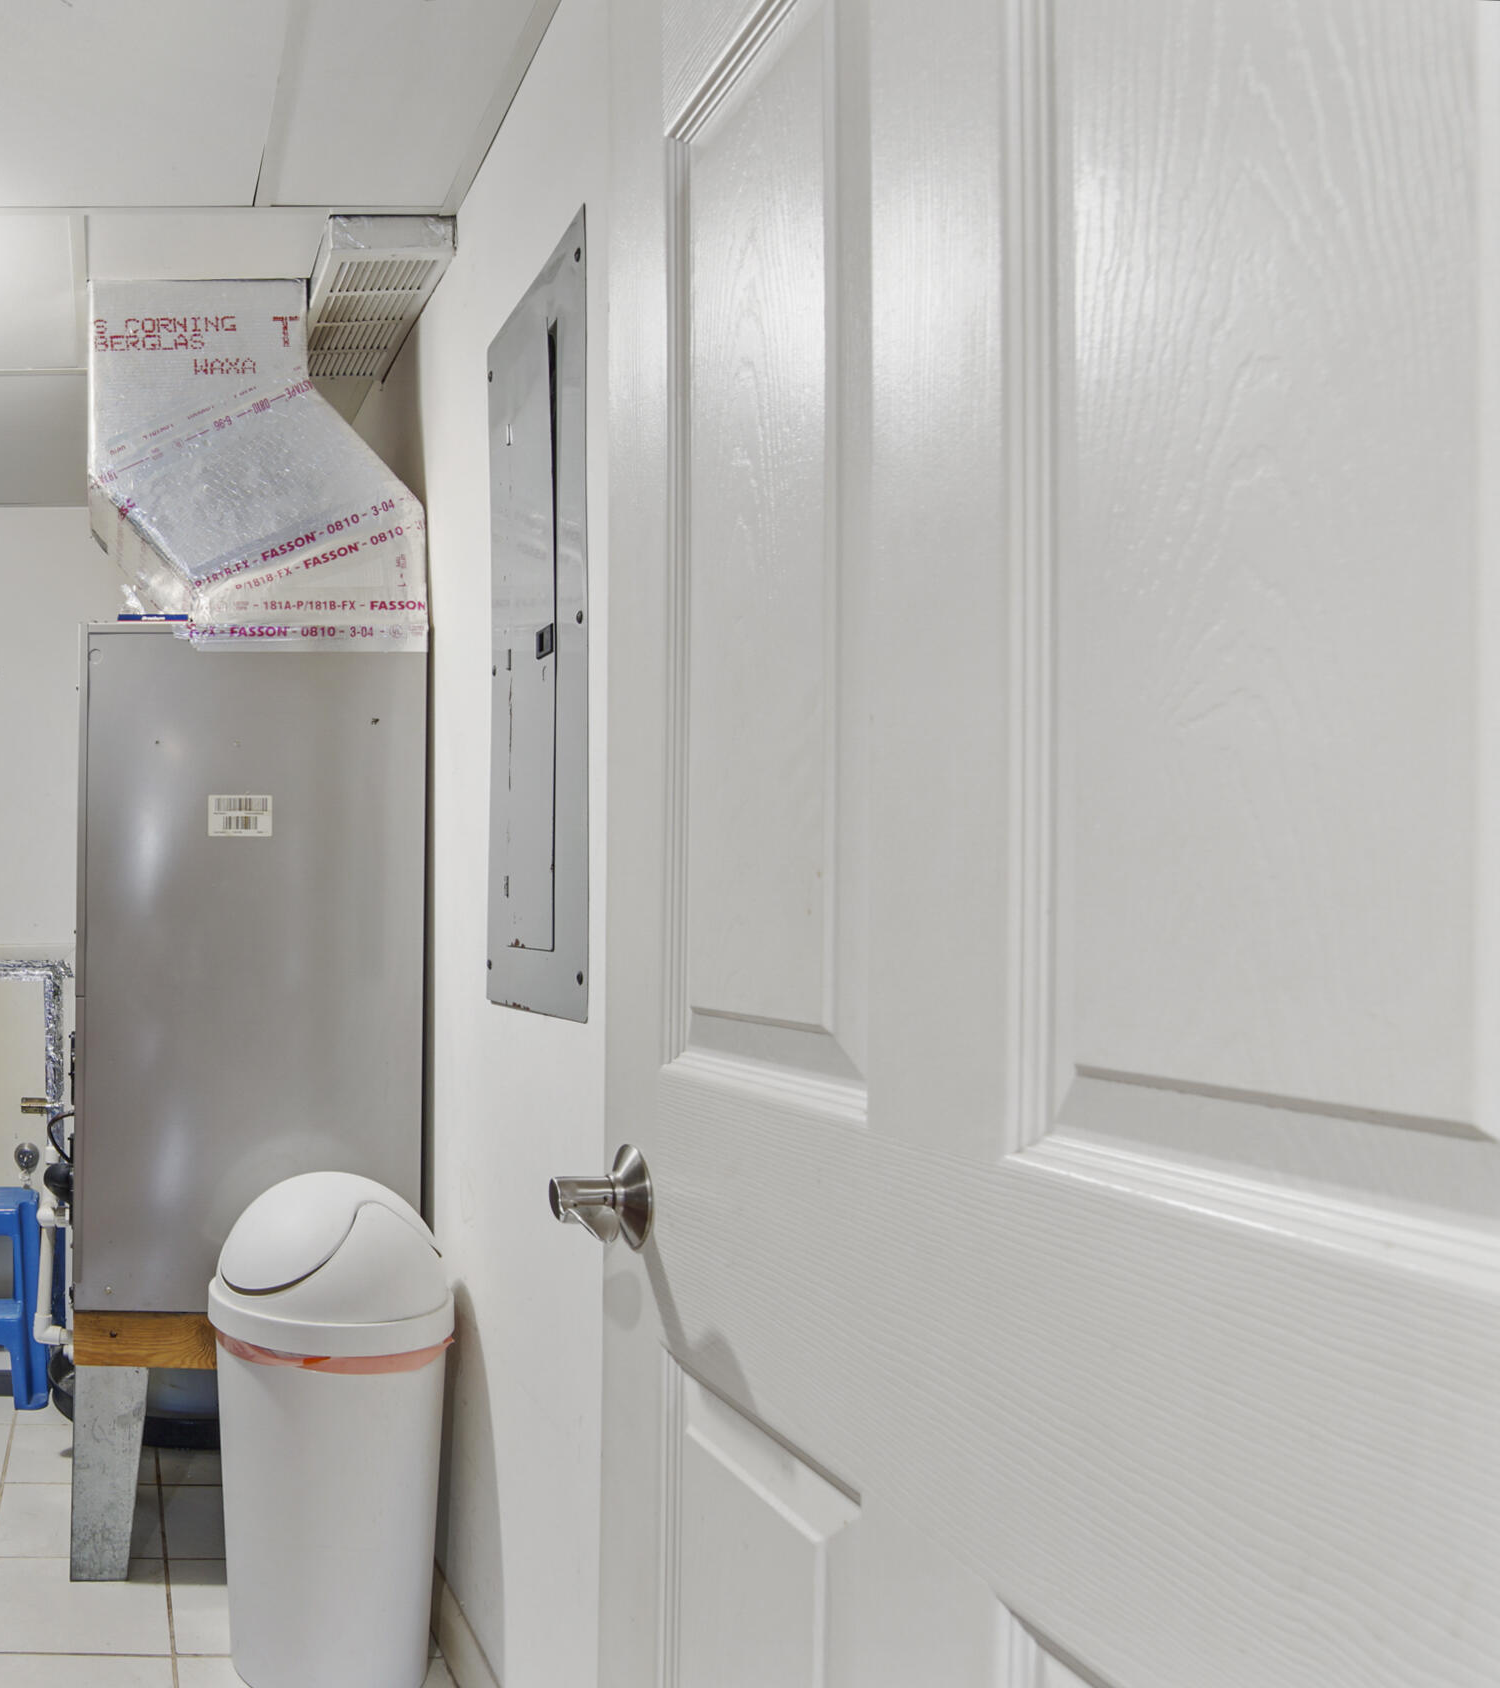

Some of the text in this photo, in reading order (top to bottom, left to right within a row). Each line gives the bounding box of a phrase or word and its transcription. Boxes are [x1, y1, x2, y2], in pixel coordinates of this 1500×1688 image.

[125, 316, 237, 333] CORNING
[95, 334, 205, 351] BERGLAS
[252, 398, 271, 414] 0810
[261, 531, 315, 562] FASSON
[326, 513, 360, 535] 0810
[371, 498, 396, 517] 3-04
[303, 542, 359, 569] FASSON
[370, 525, 404, 546] 0810
[263, 600, 357, 612] 181A-P/181B-FX
[370, 600, 426, 612] FASSON
[230, 626, 288, 638] FASSON
[301, 626, 336, 638] 0810
[350, 626, 374, 638] 3-04
